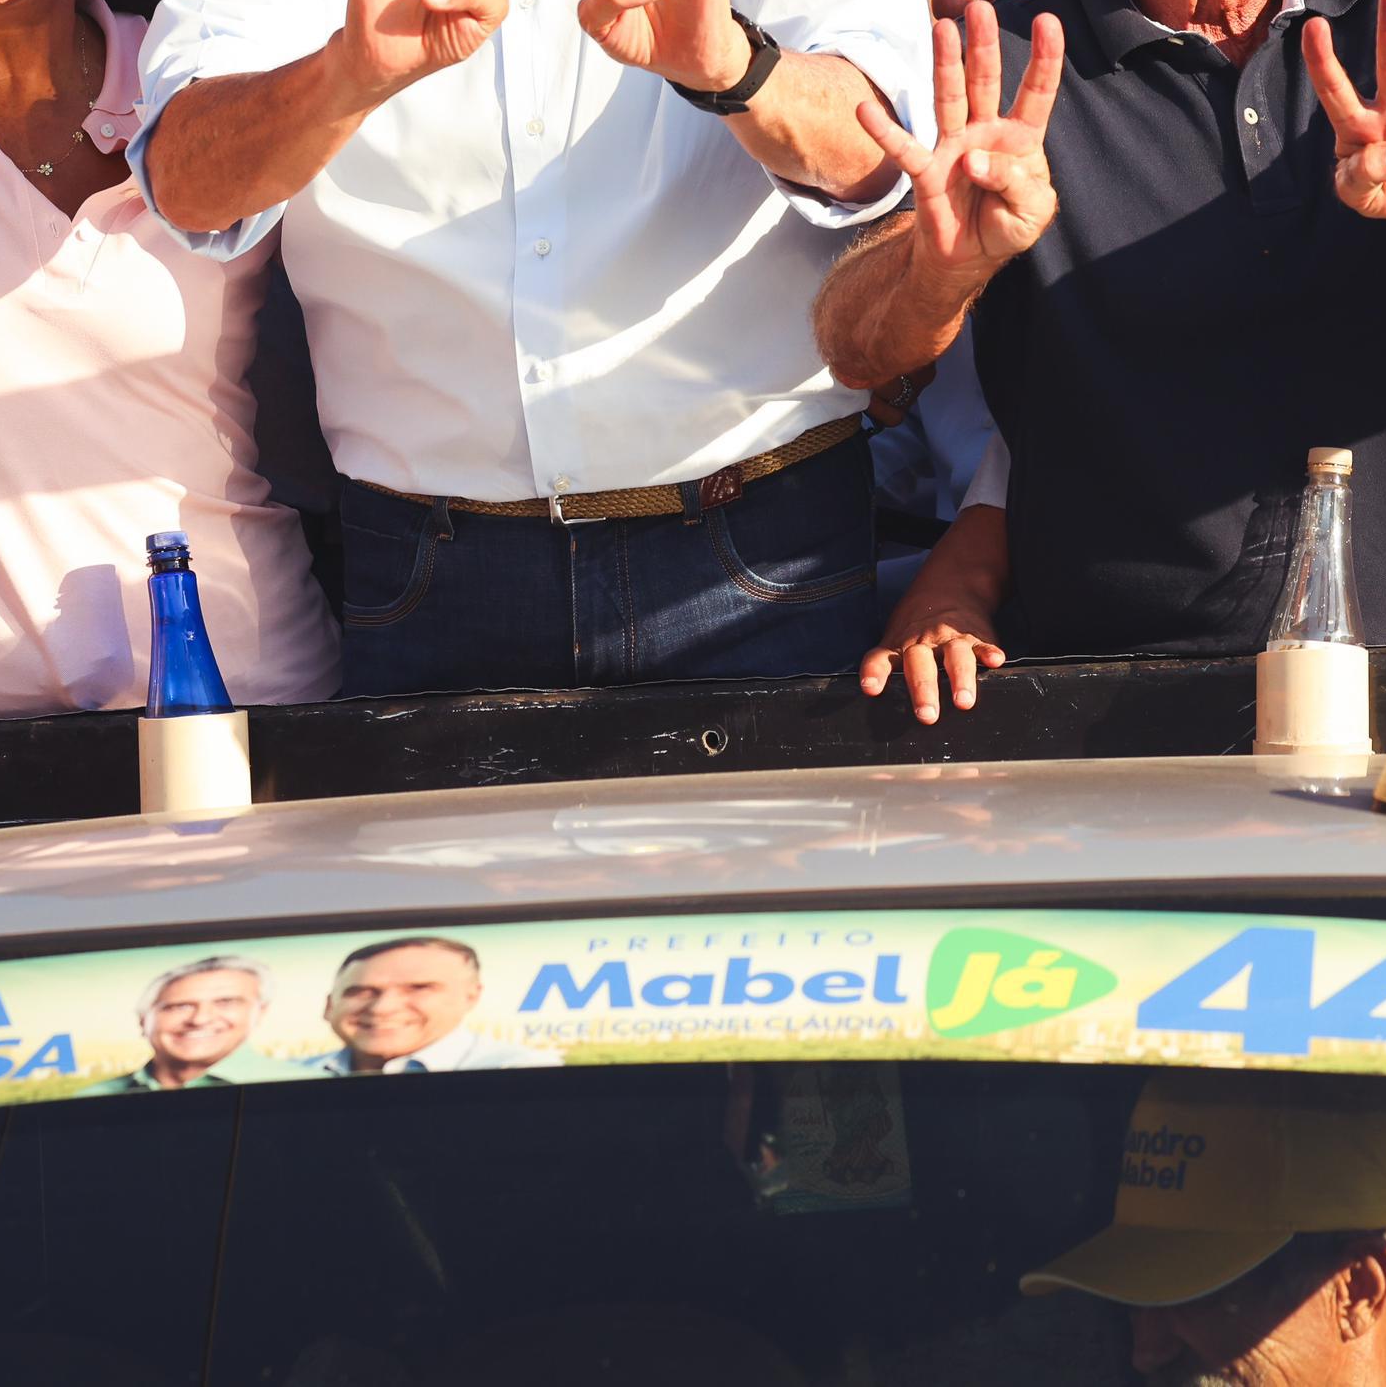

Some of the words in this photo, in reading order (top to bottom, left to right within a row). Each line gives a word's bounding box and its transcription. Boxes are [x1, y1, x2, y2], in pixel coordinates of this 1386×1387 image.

[587, 929, 874, 953] PREFEITO
[518, 953, 908, 1012] Mabel
[931, 950, 1078, 1031] Já
[523, 1020, 589, 1039] VICE
[612, 1016, 755, 1034] CORONEL
[1124, 1124, 1205, 1158] andro
